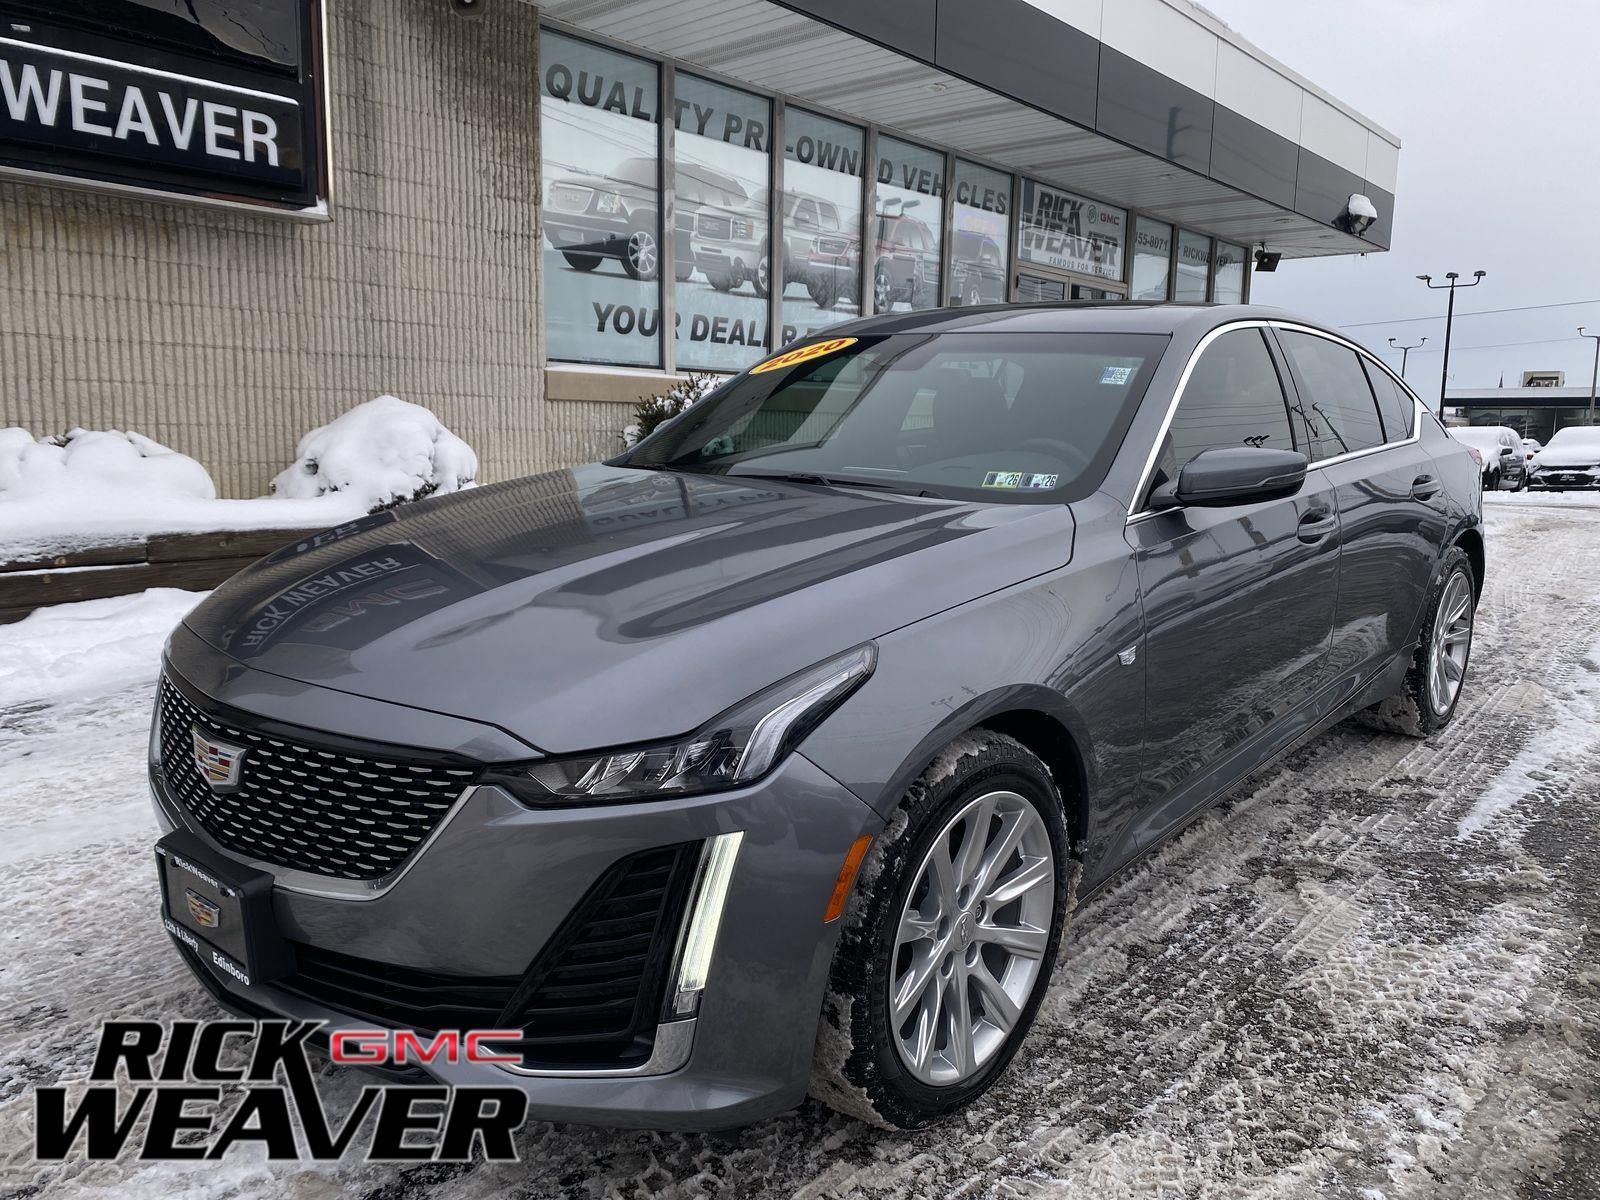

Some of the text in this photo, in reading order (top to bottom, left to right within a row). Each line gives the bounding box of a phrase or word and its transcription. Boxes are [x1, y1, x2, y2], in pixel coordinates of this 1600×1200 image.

[0, 59, 280, 168] WEAVER
[545, 64, 1007, 215] QUALTY PR-OWND VEHCLES
[1038, 190, 1084, 225] RICK
[1100, 212, 1120, 226] GMC
[1023, 215, 1120, 267] WEAVER
[1135, 231, 1168, 251] 55-8071
[1049, 256, 1115, 277] FAMOUS FOR SERVICE
[690, 313, 797, 348] DEALR
[759, 339, 848, 370] 2020
[212, 951, 250, 986] Edinboro
